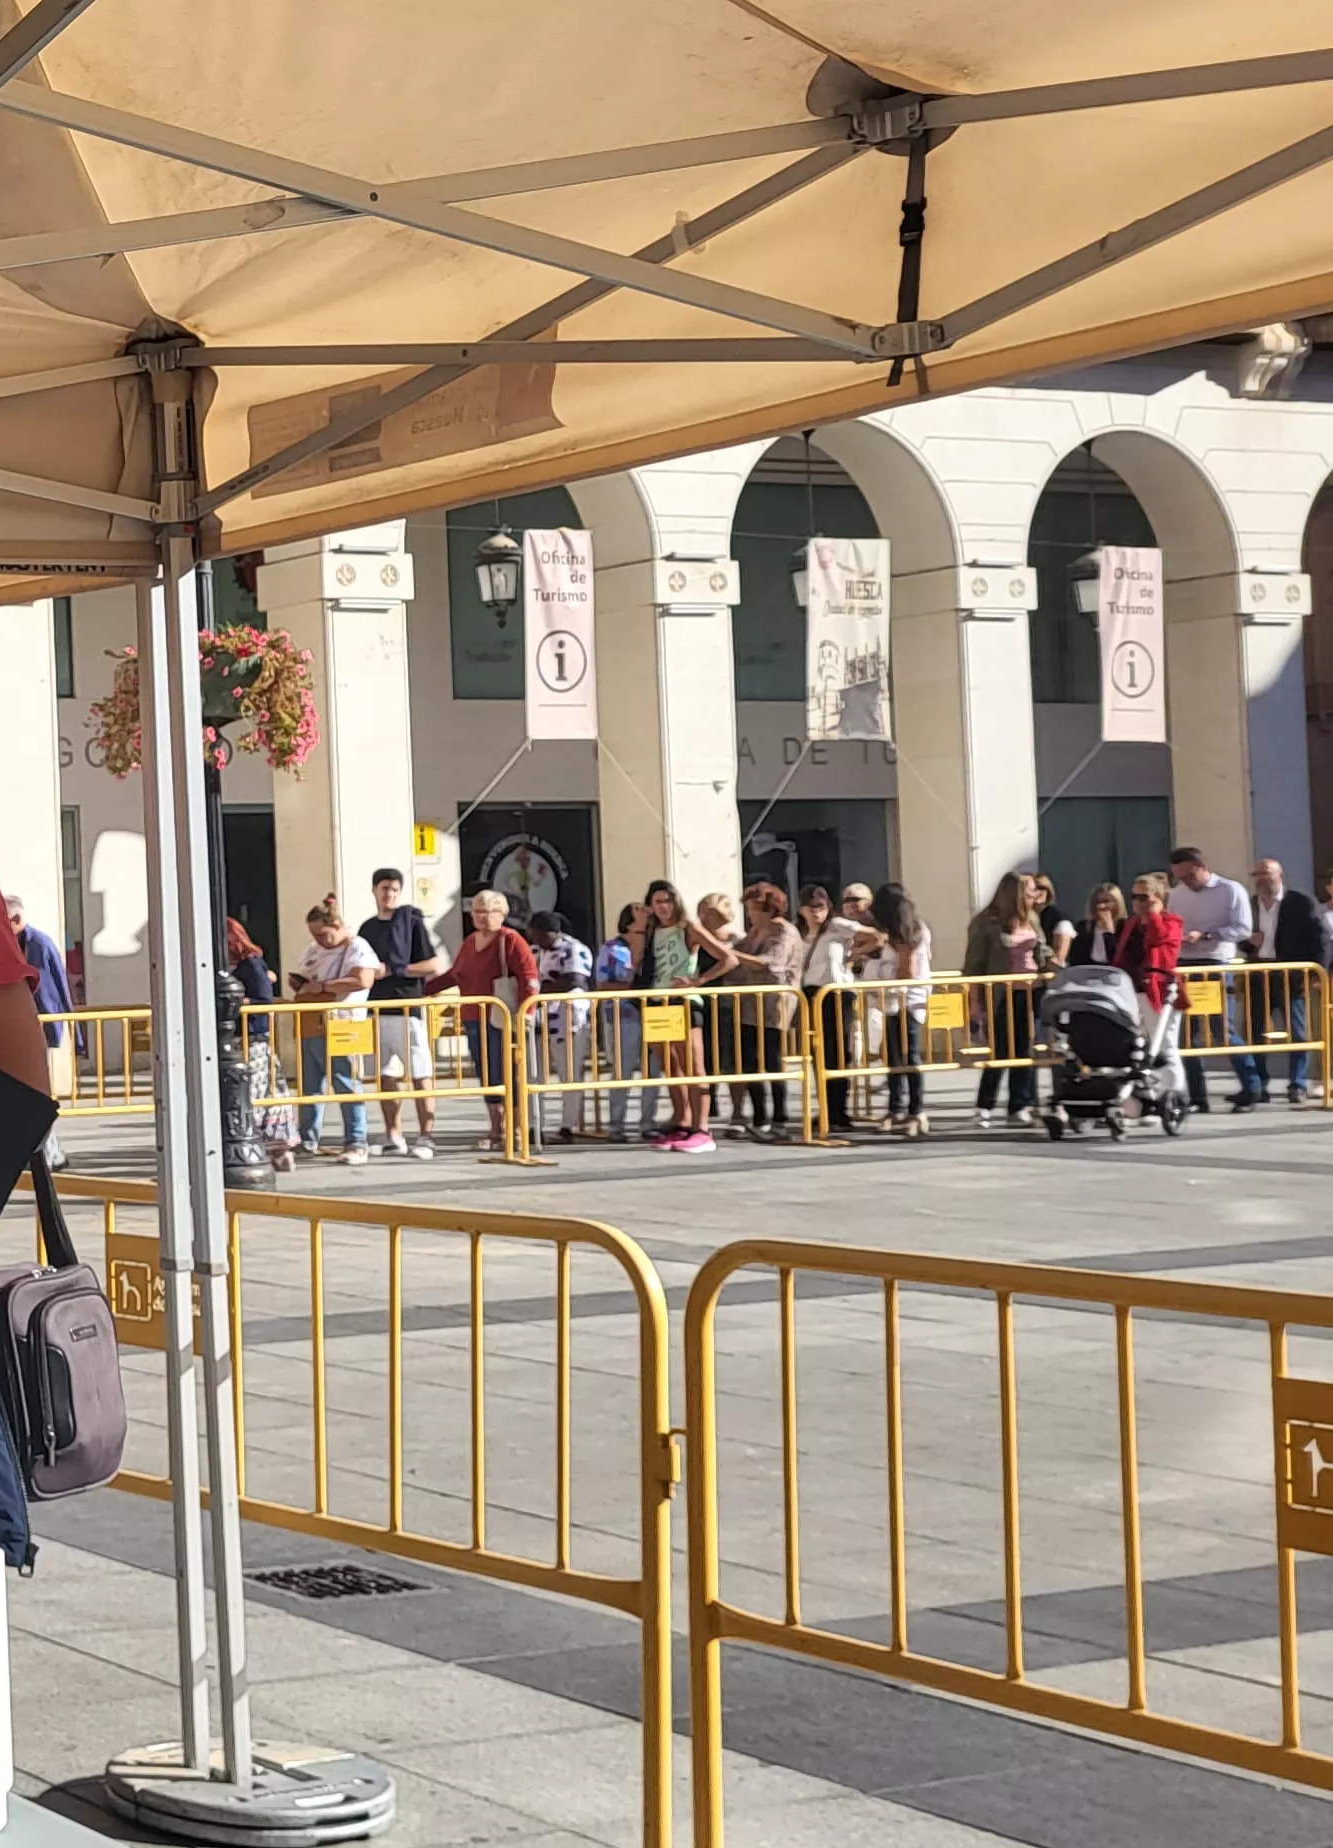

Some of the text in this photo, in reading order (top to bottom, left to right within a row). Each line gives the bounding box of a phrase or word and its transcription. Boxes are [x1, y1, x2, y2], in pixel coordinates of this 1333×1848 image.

[541, 551, 586, 566] Oficina
[570, 571, 587, 585] de
[533, 588, 588, 603] Turismo
[845, 580, 883, 600] HUESCA
[1140, 588, 1154, 599] de
[1107, 602, 1154, 616] Turismo
